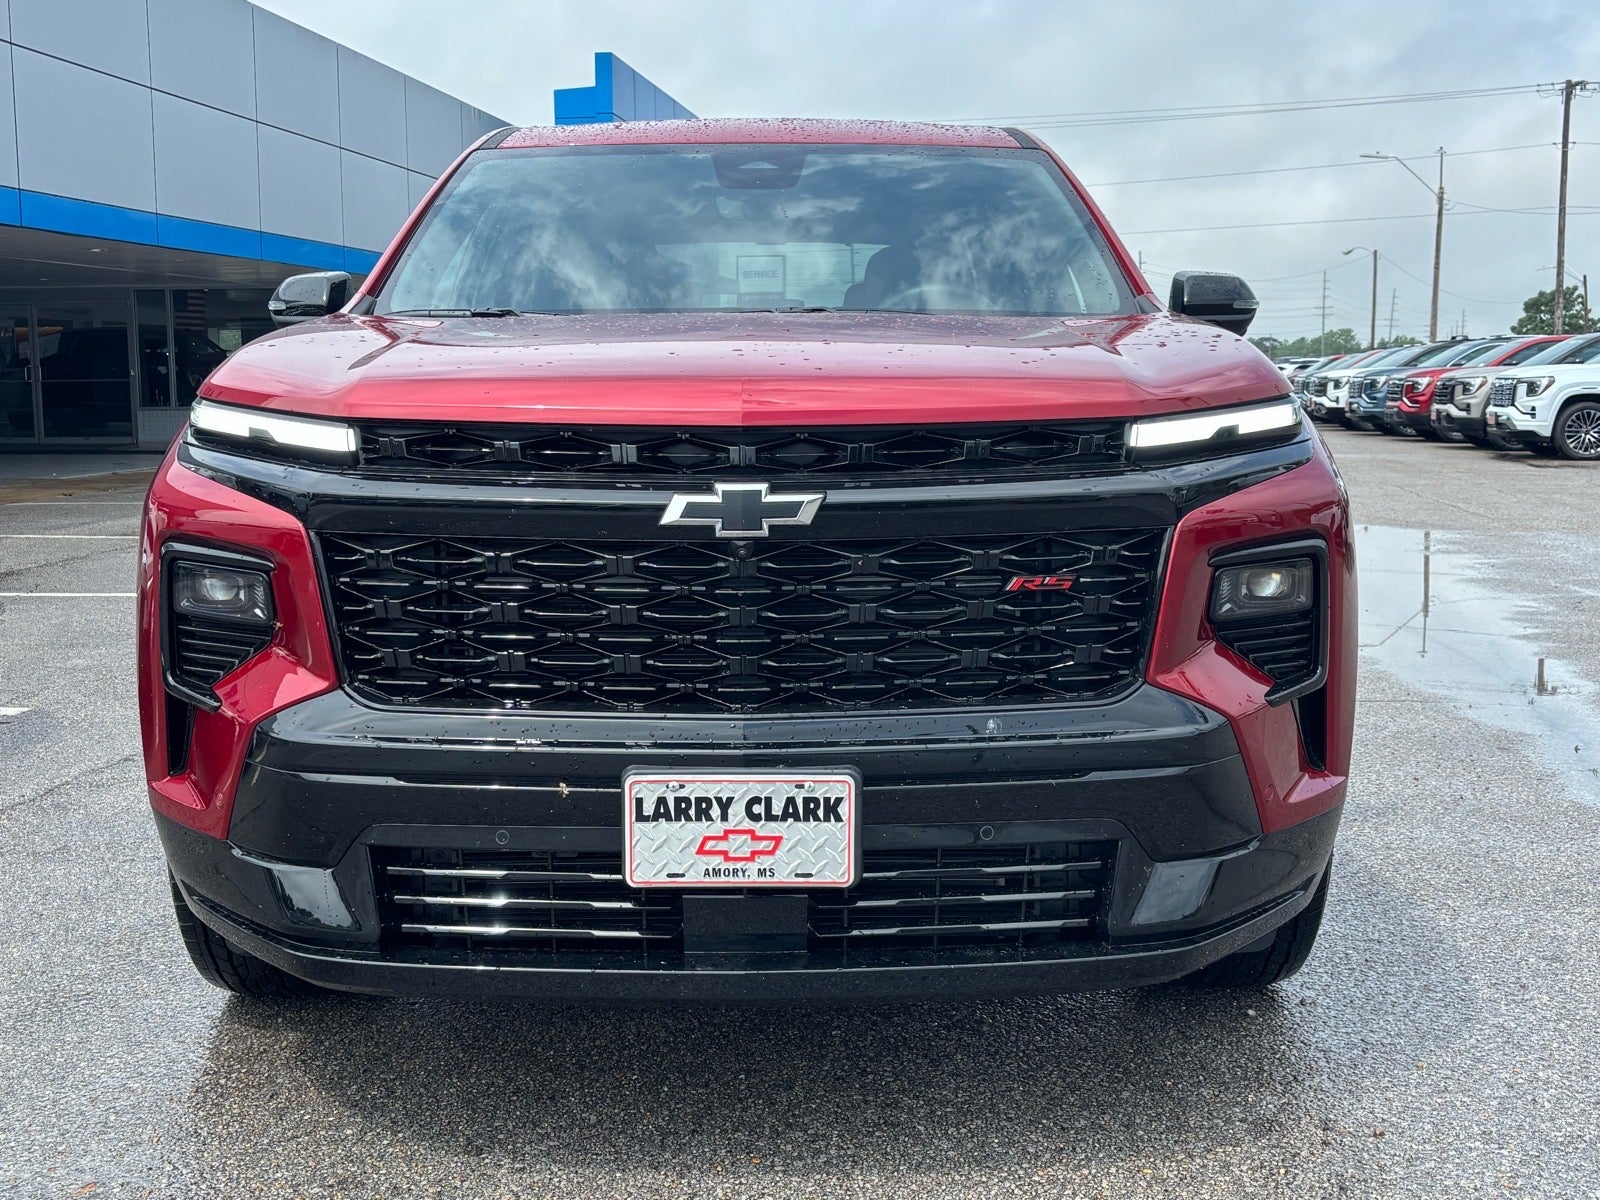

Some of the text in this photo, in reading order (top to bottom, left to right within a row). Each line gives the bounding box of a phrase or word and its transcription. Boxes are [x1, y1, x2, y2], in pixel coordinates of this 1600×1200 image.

[742, 270, 780, 279] SERVICE
[1004, 575, 1077, 592] RS
[634, 796, 845, 823] LARRY CLARK
[703, 867, 776, 880] AMORY, MS
